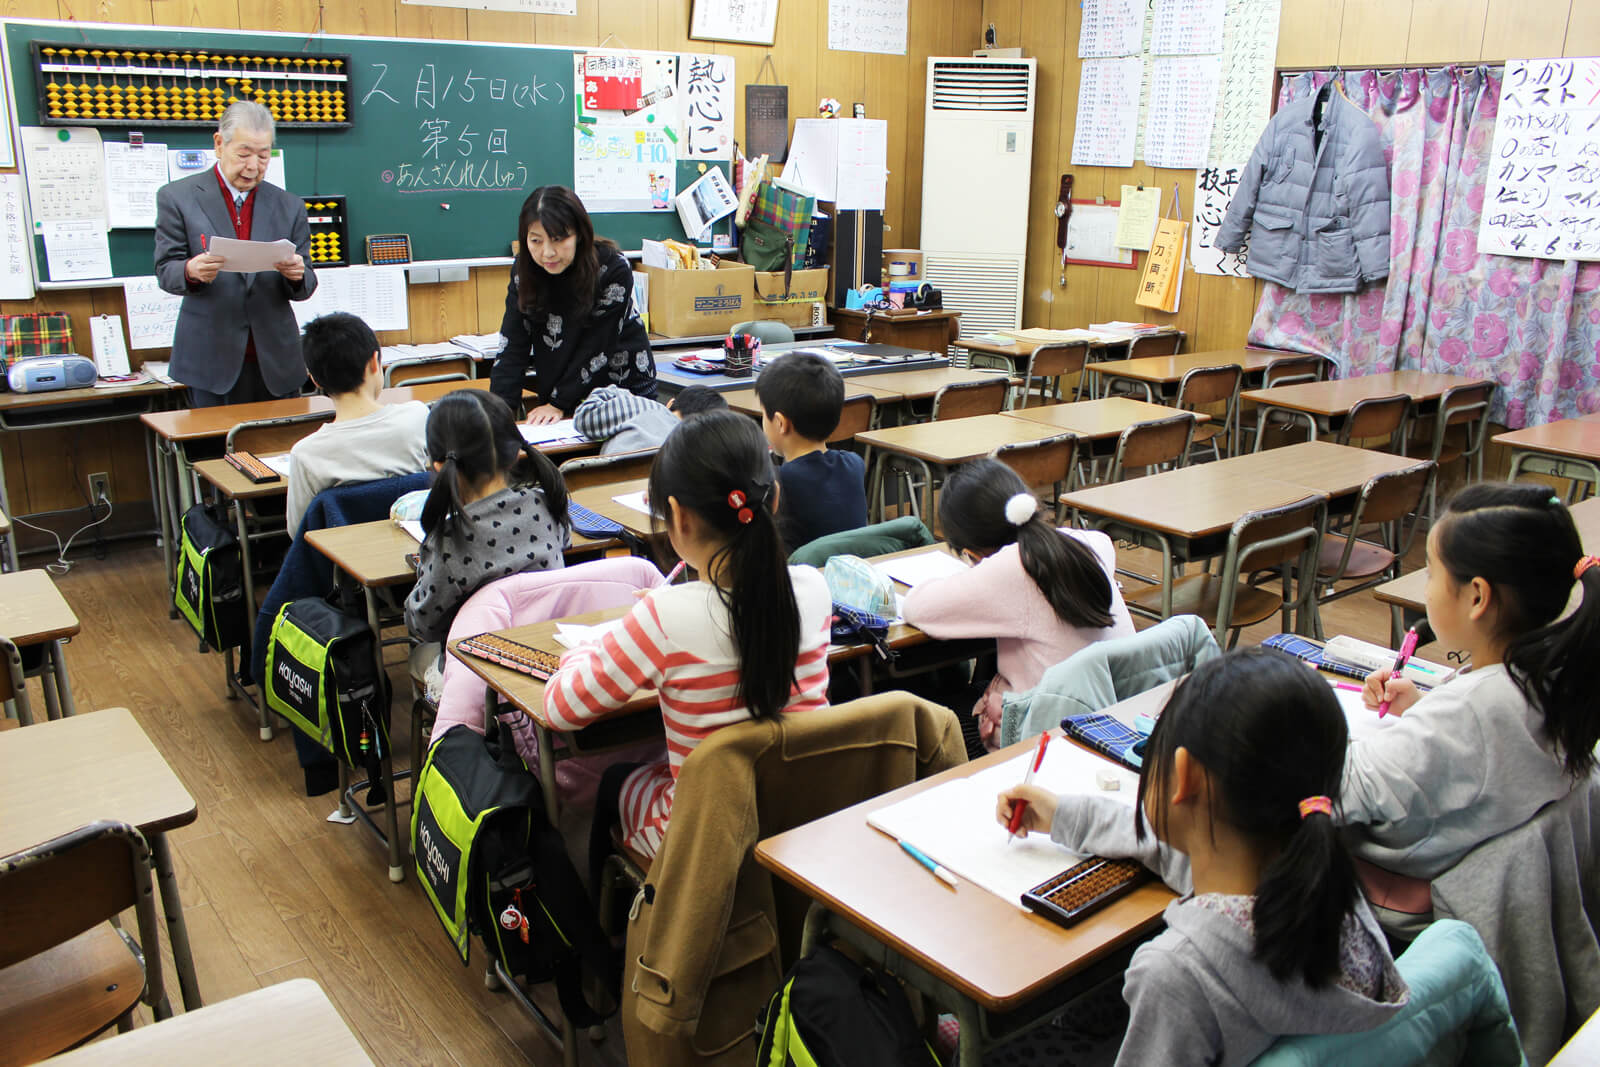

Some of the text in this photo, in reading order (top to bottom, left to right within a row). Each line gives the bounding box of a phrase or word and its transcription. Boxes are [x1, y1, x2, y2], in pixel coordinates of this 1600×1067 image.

[361, 63, 565, 110] 2月15日(水)
[1512, 60, 1574, 88] うっかり
[585, 80, 599, 108] あと
[687, 56, 726, 156] 熱心に
[419, 117, 508, 159] 第5回
[396, 159, 528, 187] あんざんれんしゅう
[1499, 161, 1558, 183] カンマ
[1196, 168, 1226, 248] 技と心を
[1144, 230, 1170, 294] 一刀両断
[813, 305, 821, 326] BOSS
